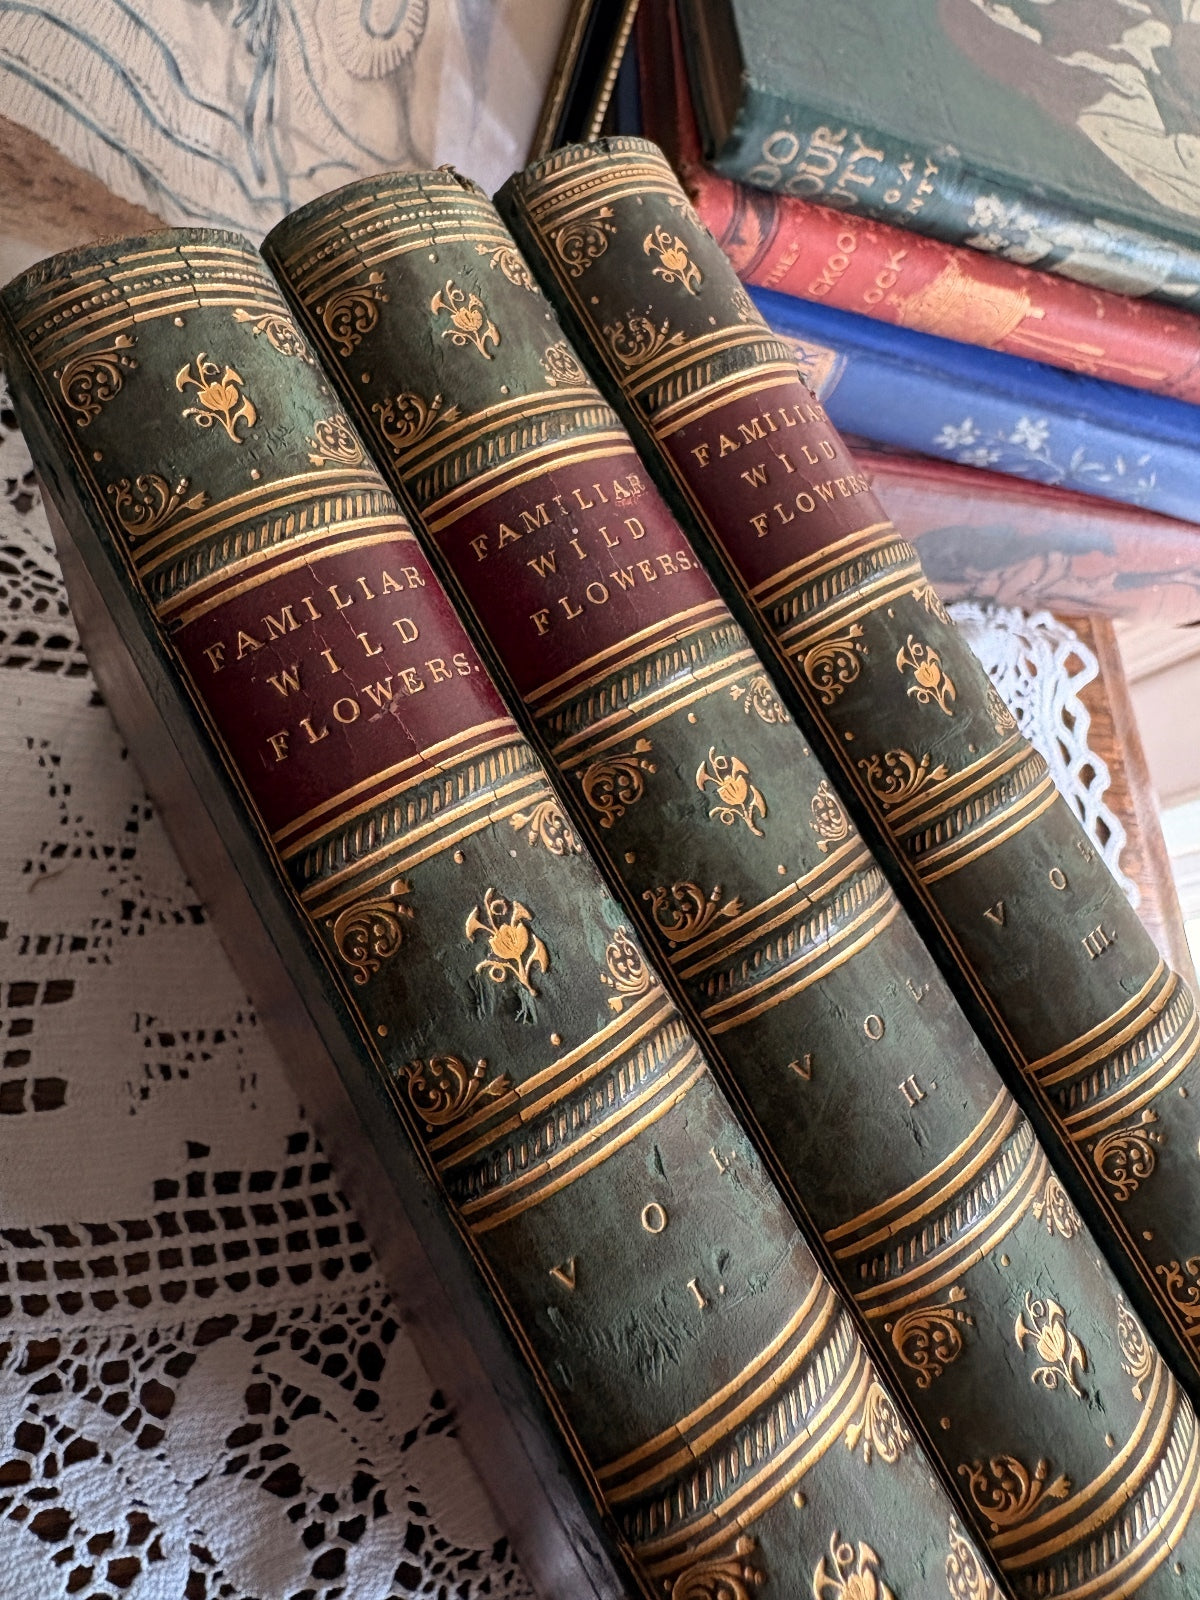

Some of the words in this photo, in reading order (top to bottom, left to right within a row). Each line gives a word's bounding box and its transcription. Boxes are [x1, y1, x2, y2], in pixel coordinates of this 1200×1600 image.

[783, 125, 848, 197] OUR
[824, 132, 884, 208] UTY
[808, 230, 858, 297] CKOO
[863, 249, 908, 305] OCK
[740, 439, 837, 489] WILD
[468, 472, 646, 562] FAMILIAR
[526, 516, 646, 579] WILD
[203, 566, 426, 673] FAMILIAR
[529, 550, 699, 636] FLOWERS.
[266, 617, 420, 697] WILD
[266, 652, 481, 762] FLOWERS.
